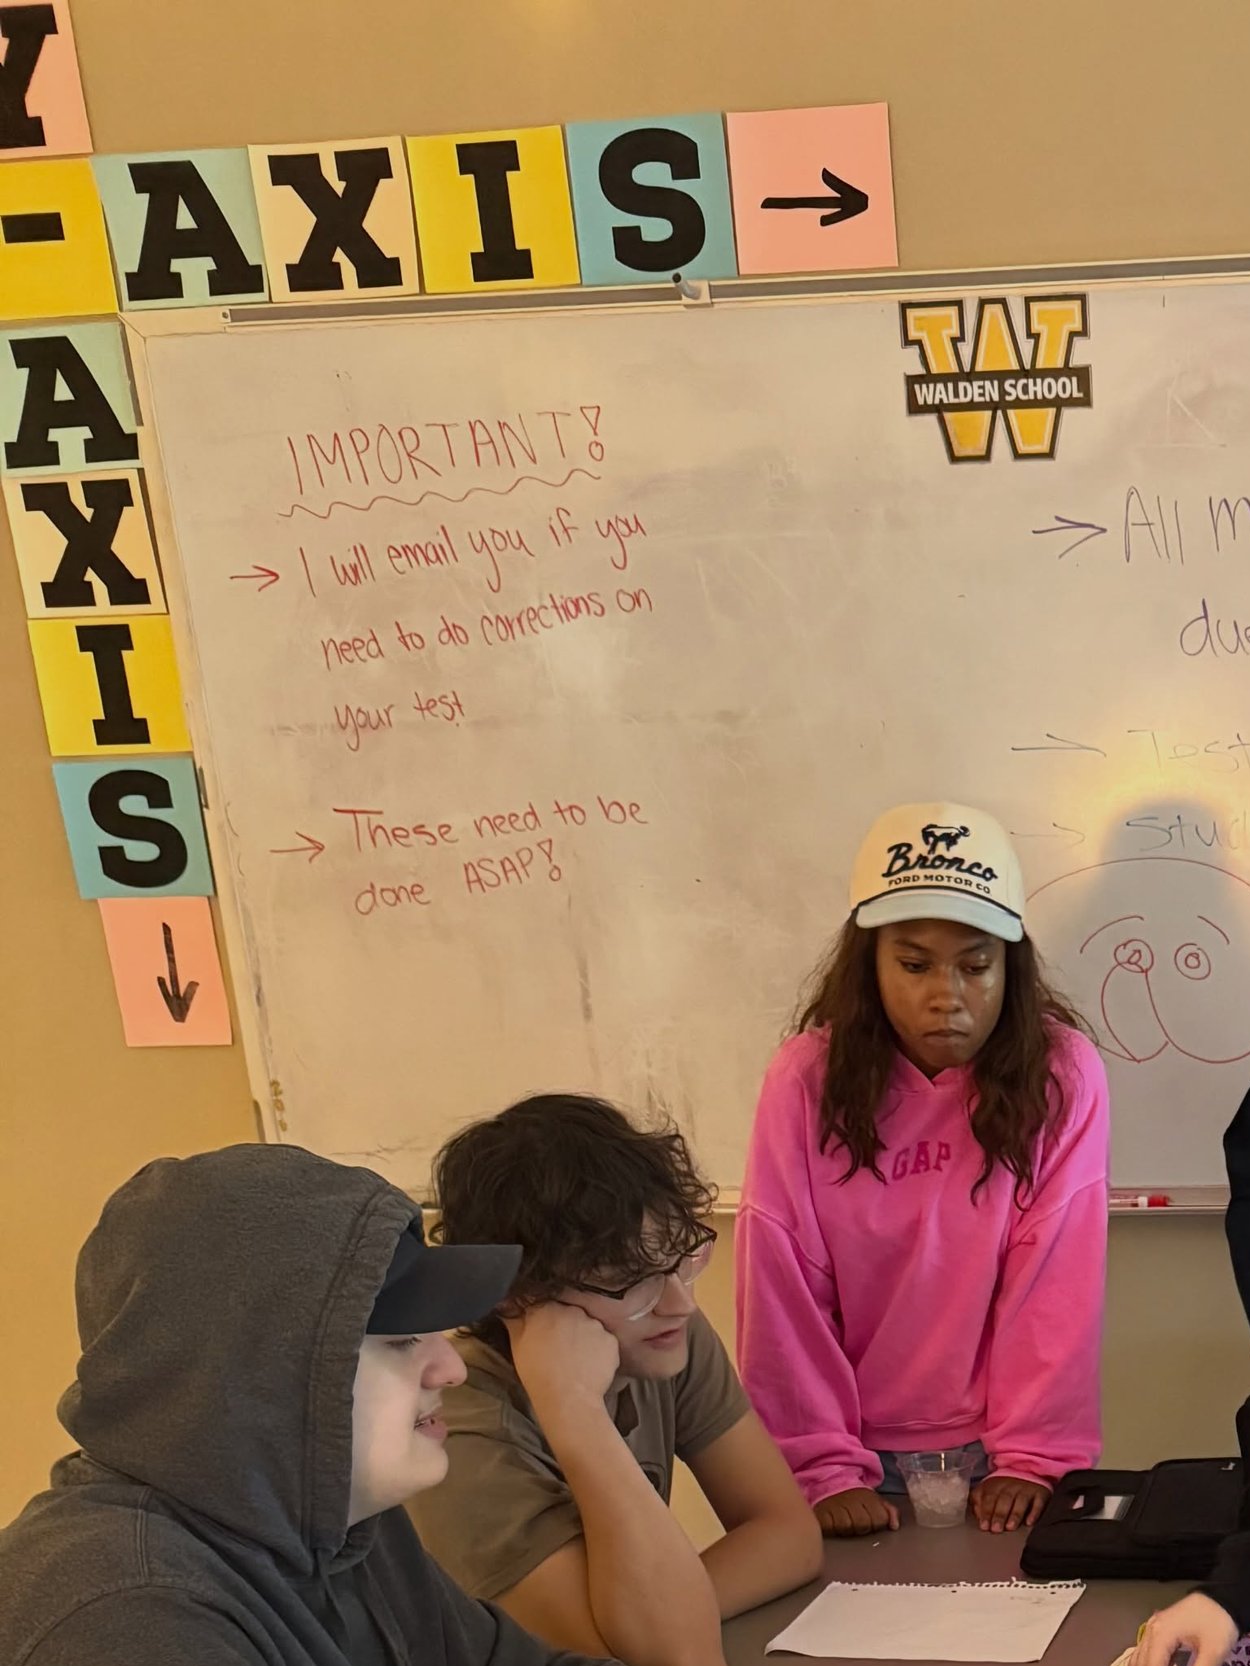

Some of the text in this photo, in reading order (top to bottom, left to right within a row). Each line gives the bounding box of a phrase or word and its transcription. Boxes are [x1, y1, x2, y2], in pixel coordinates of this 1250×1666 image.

[914, 376, 1083, 405] WALDEN SCHOOL
[287, 405, 605, 495] IMPORTANT!
[299, 507, 647, 598] I will email you if you
[1125, 486, 1183, 565] All
[320, 588, 653, 670] need to do corrections on
[334, 703, 394, 751] your
[333, 795, 649, 852] These need to be
[355, 838, 562, 915] done ASAP!
[882, 842, 998, 882] Bronco
[888, 875, 919, 886] FORD
[924, 874, 972, 887] MOTOR
[891, 1140, 951, 1181] GAP
